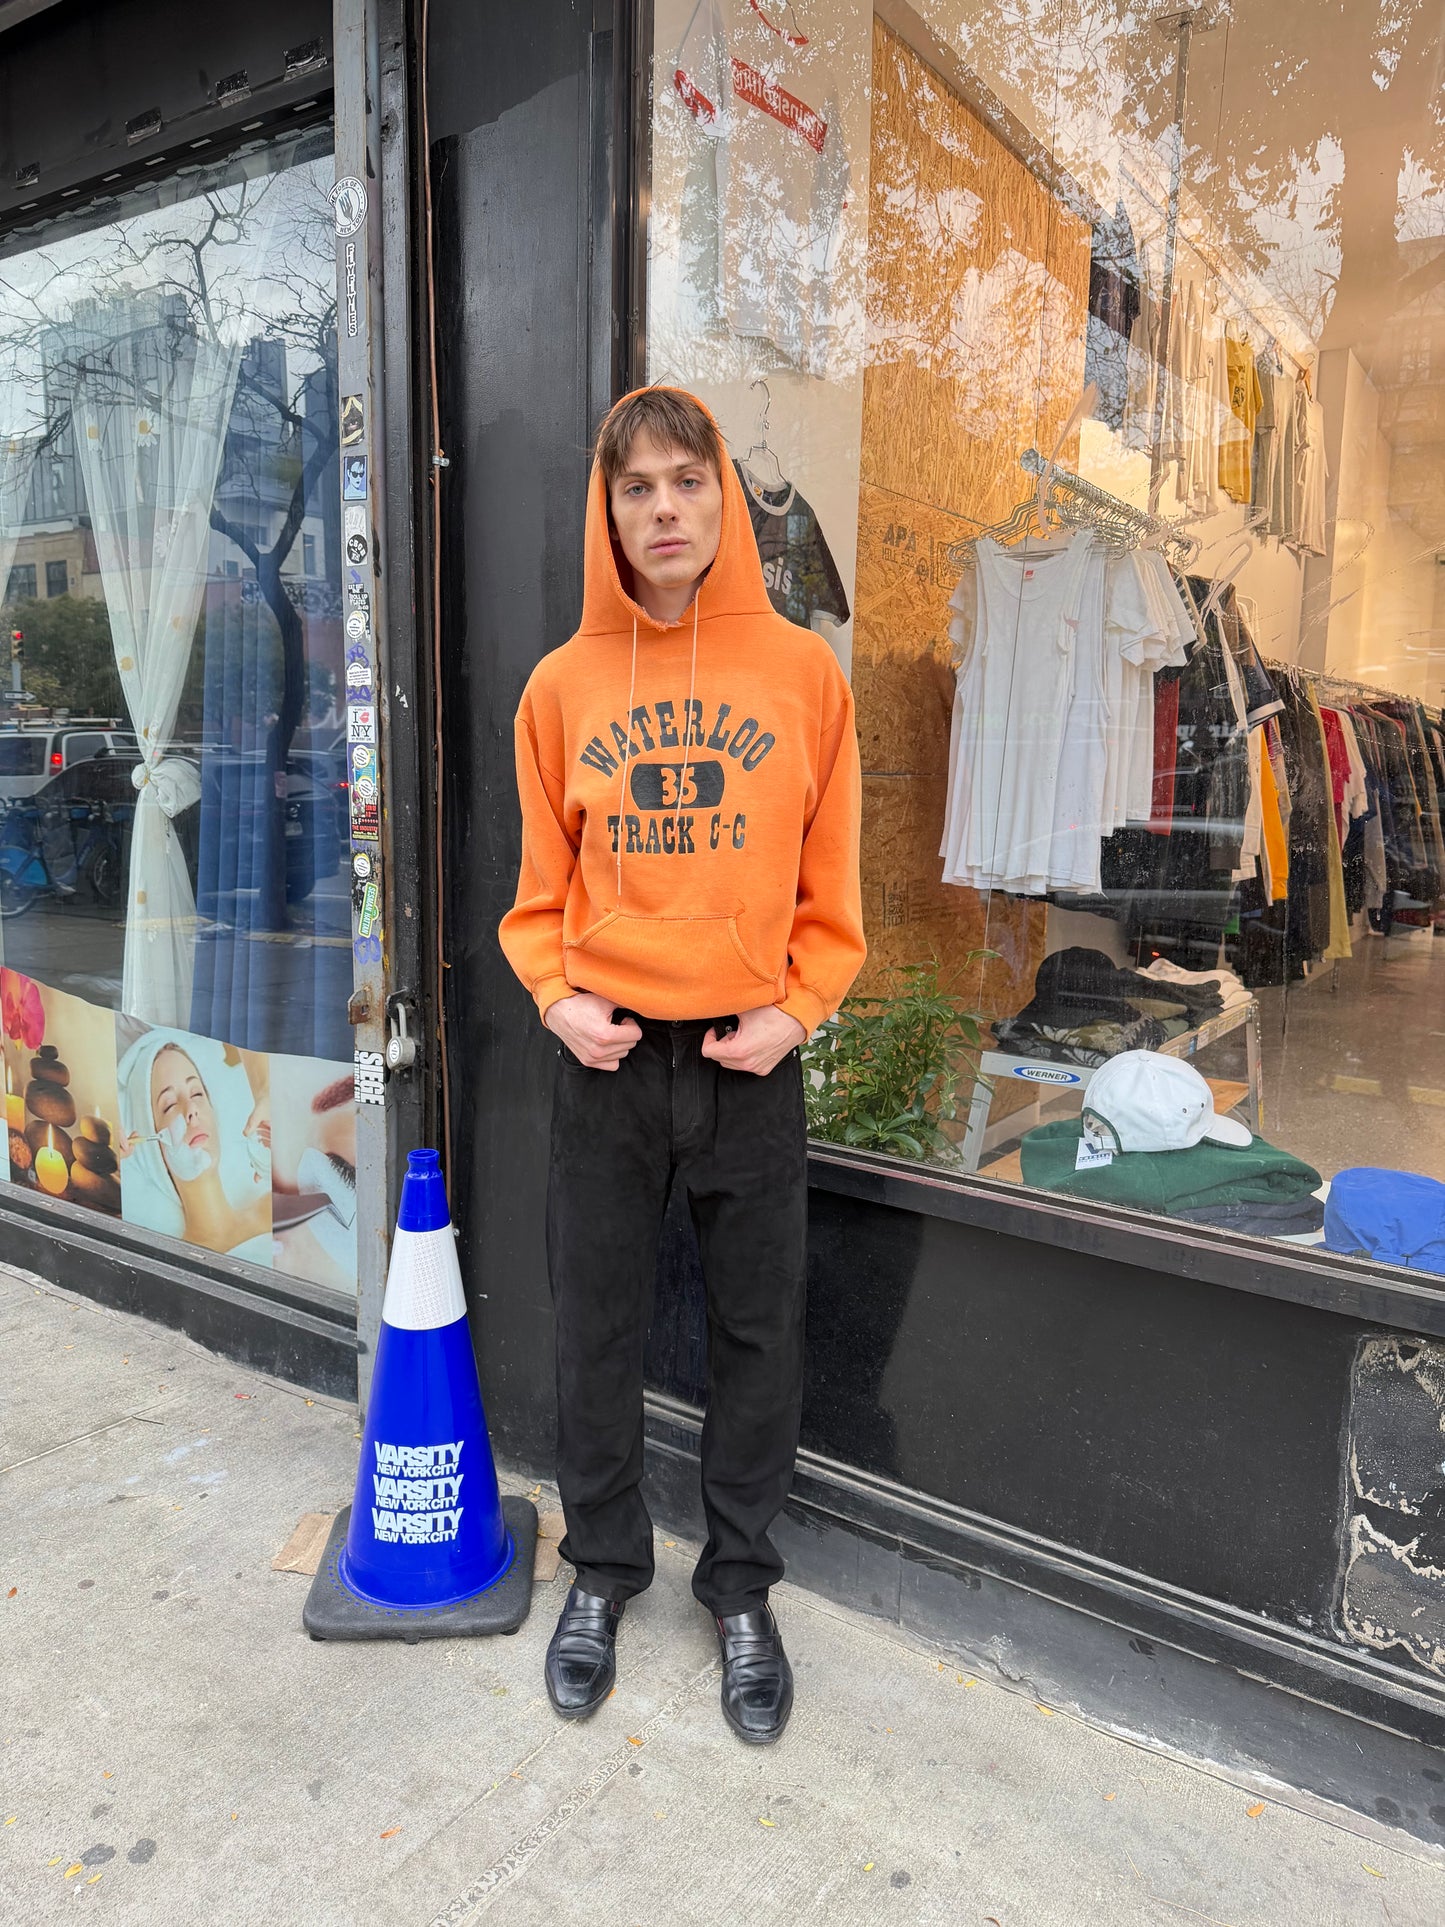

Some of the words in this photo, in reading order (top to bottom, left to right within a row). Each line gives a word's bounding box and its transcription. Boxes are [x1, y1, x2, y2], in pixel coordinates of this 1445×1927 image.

[335, 181, 349, 195] FORK
[340, 225, 352, 234] NEW
[352, 208, 364, 226] YORK
[882, 522, 917, 553] APA
[351, 724, 372, 737] NY
[353, 711, 358, 724] I
[579, 699, 775, 778] WATERLOO
[661, 766, 698, 806] 35
[607, 815, 695, 854] TRACK
[710, 813, 746, 850] C-C
[360, 1051, 385, 1105] SIEGE
[1027, 1069, 1068, 1081] WERNER
[374, 1440, 464, 1467] VARSITY
[376, 1462, 400, 1477] NEW
[402, 1466, 432, 1478] YORK
[431, 1462, 459, 1477] CITY
[372, 1473, 464, 1500] VARSITY
[375, 1495, 400, 1510] NEW
[401, 1499, 431, 1511] YORK
[430, 1495, 459, 1510] CITY
[371, 1507, 464, 1533] VARSITY
[374, 1528, 399, 1543] NEW
[400, 1532, 431, 1544] YORK
[430, 1528, 459, 1543] CITY
